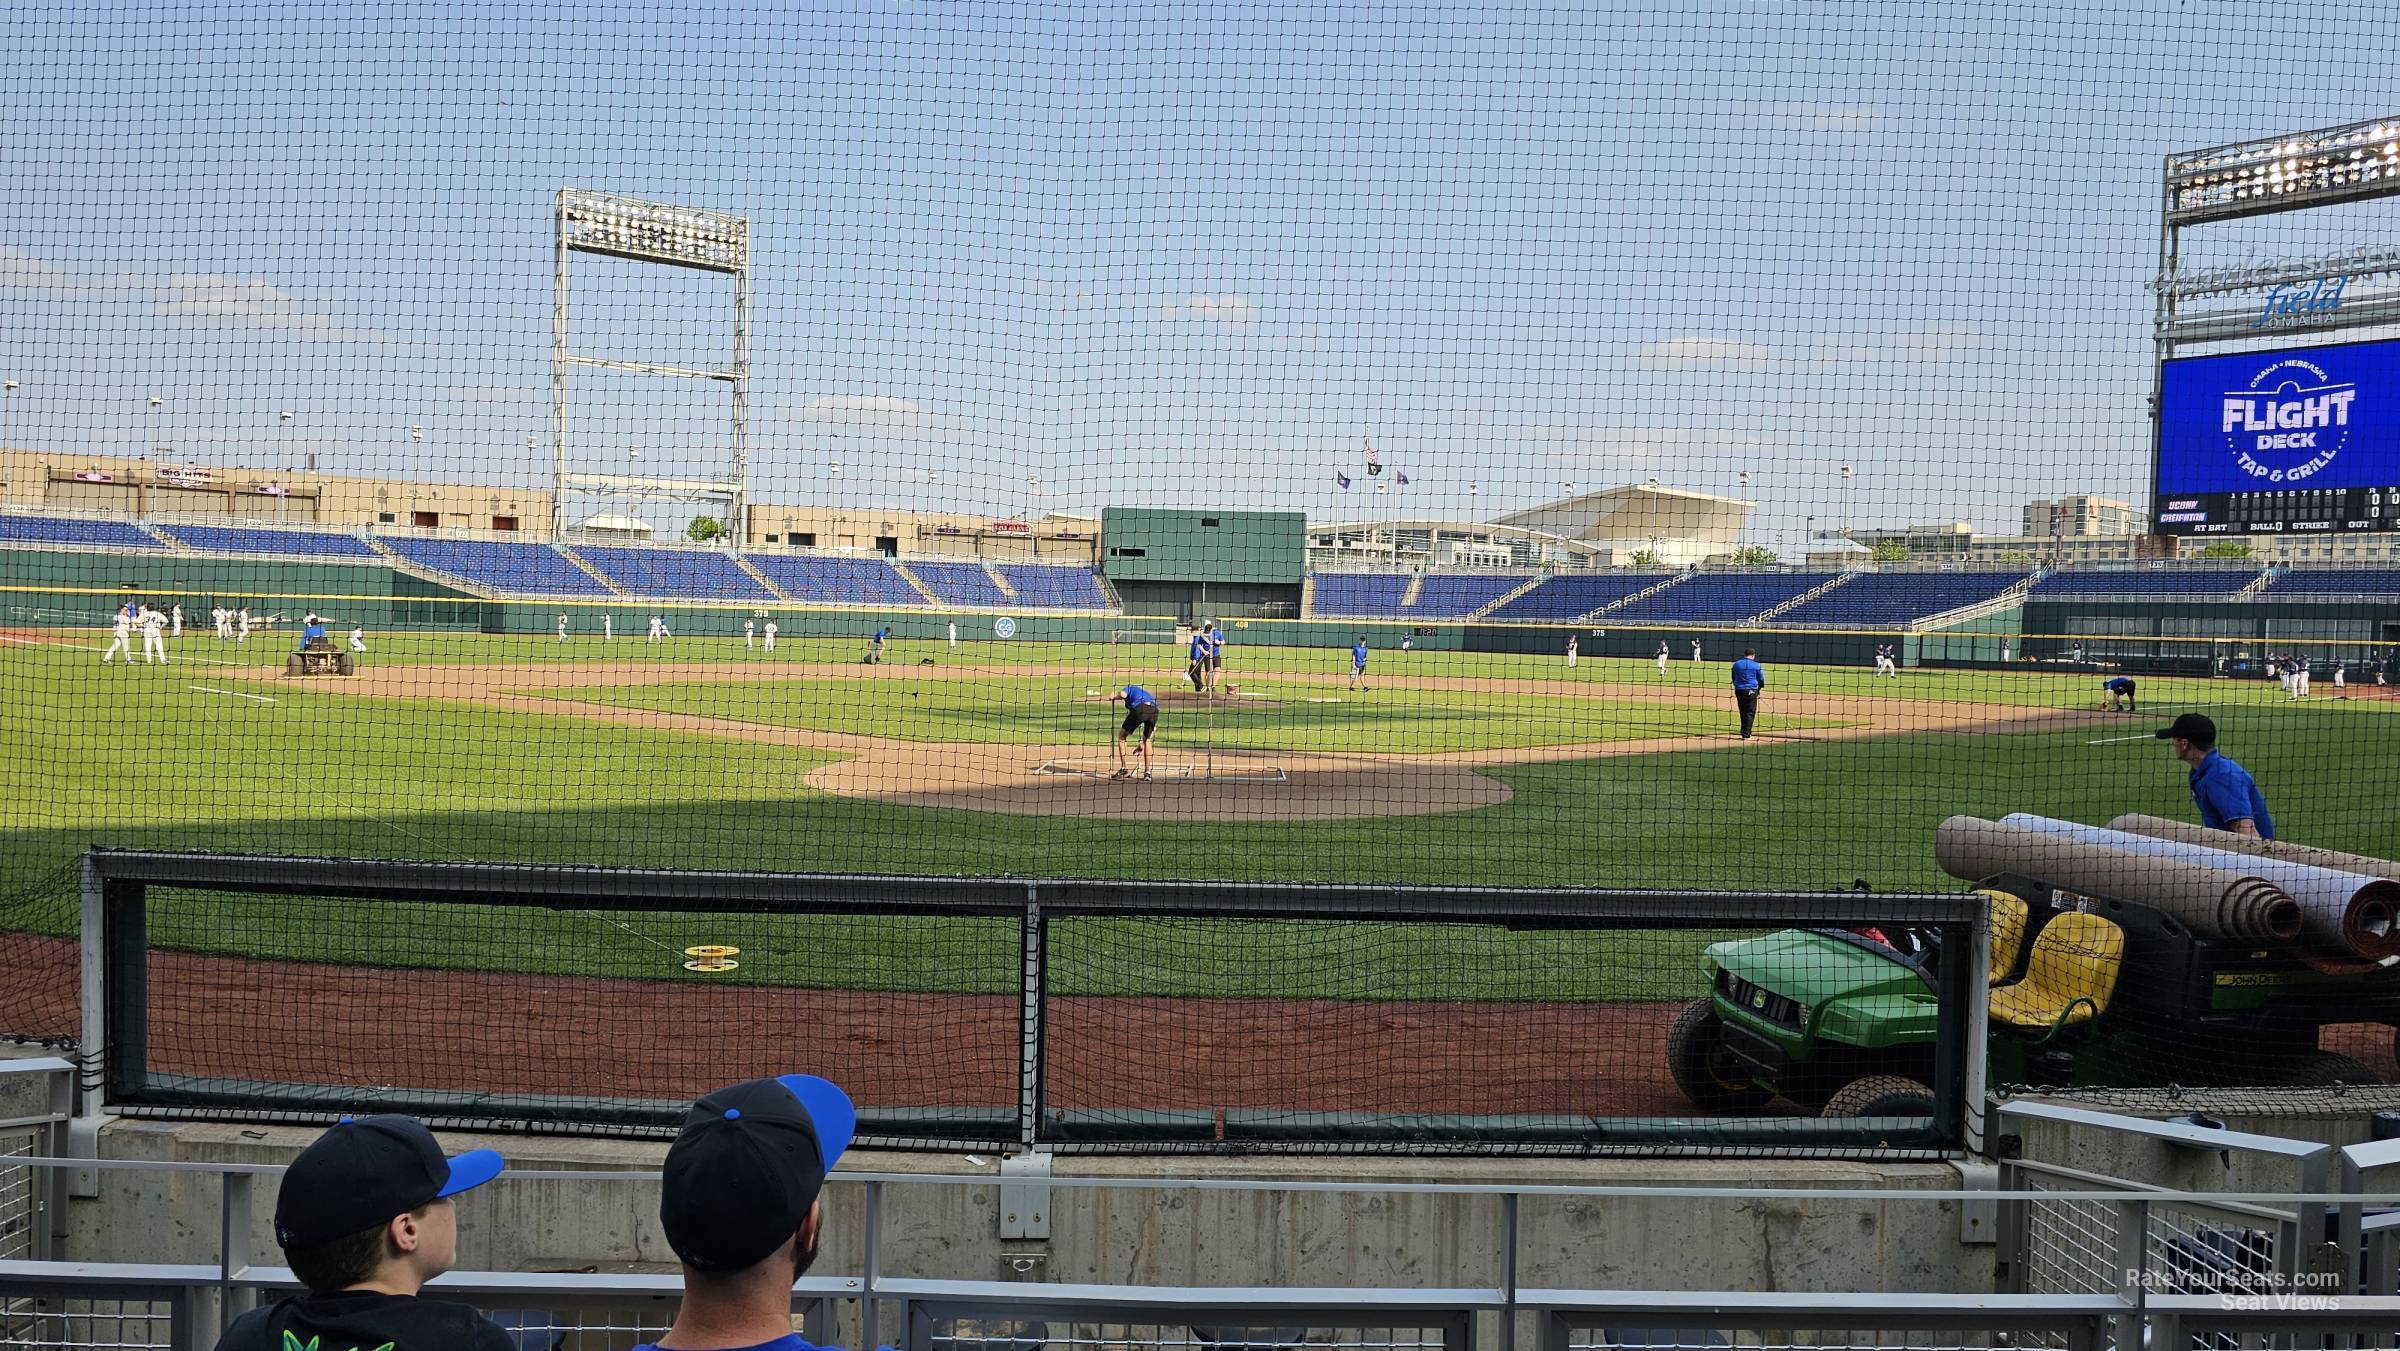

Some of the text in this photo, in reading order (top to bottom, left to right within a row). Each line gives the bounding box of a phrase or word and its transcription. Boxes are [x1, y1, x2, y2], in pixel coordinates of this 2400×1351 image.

[2251, 274, 2349, 329] field
[2268, 313, 2335, 329] OMAHA
[2250, 359, 2328, 389] OMAHA NEBRASKA
[2223, 389, 2356, 433] FLIGHT
[2257, 432, 2318, 450] DECK
[2237, 449, 2337, 482] TAP & GRILL
[2371, 493, 2380, 505] 0
[2391, 493, 2400, 505] 0
[2371, 506, 2380, 518] 0
[2193, 524, 2228, 532] AT BAT
[2250, 521, 2283, 531] BALL 0
[2292, 521, 2330, 530] STRIKE
[2348, 520, 2370, 528] OUT
[753, 610, 769, 618] 375
[1592, 629, 1605, 637] 375
[2231, 974, 2292, 986] JOHN DEE
